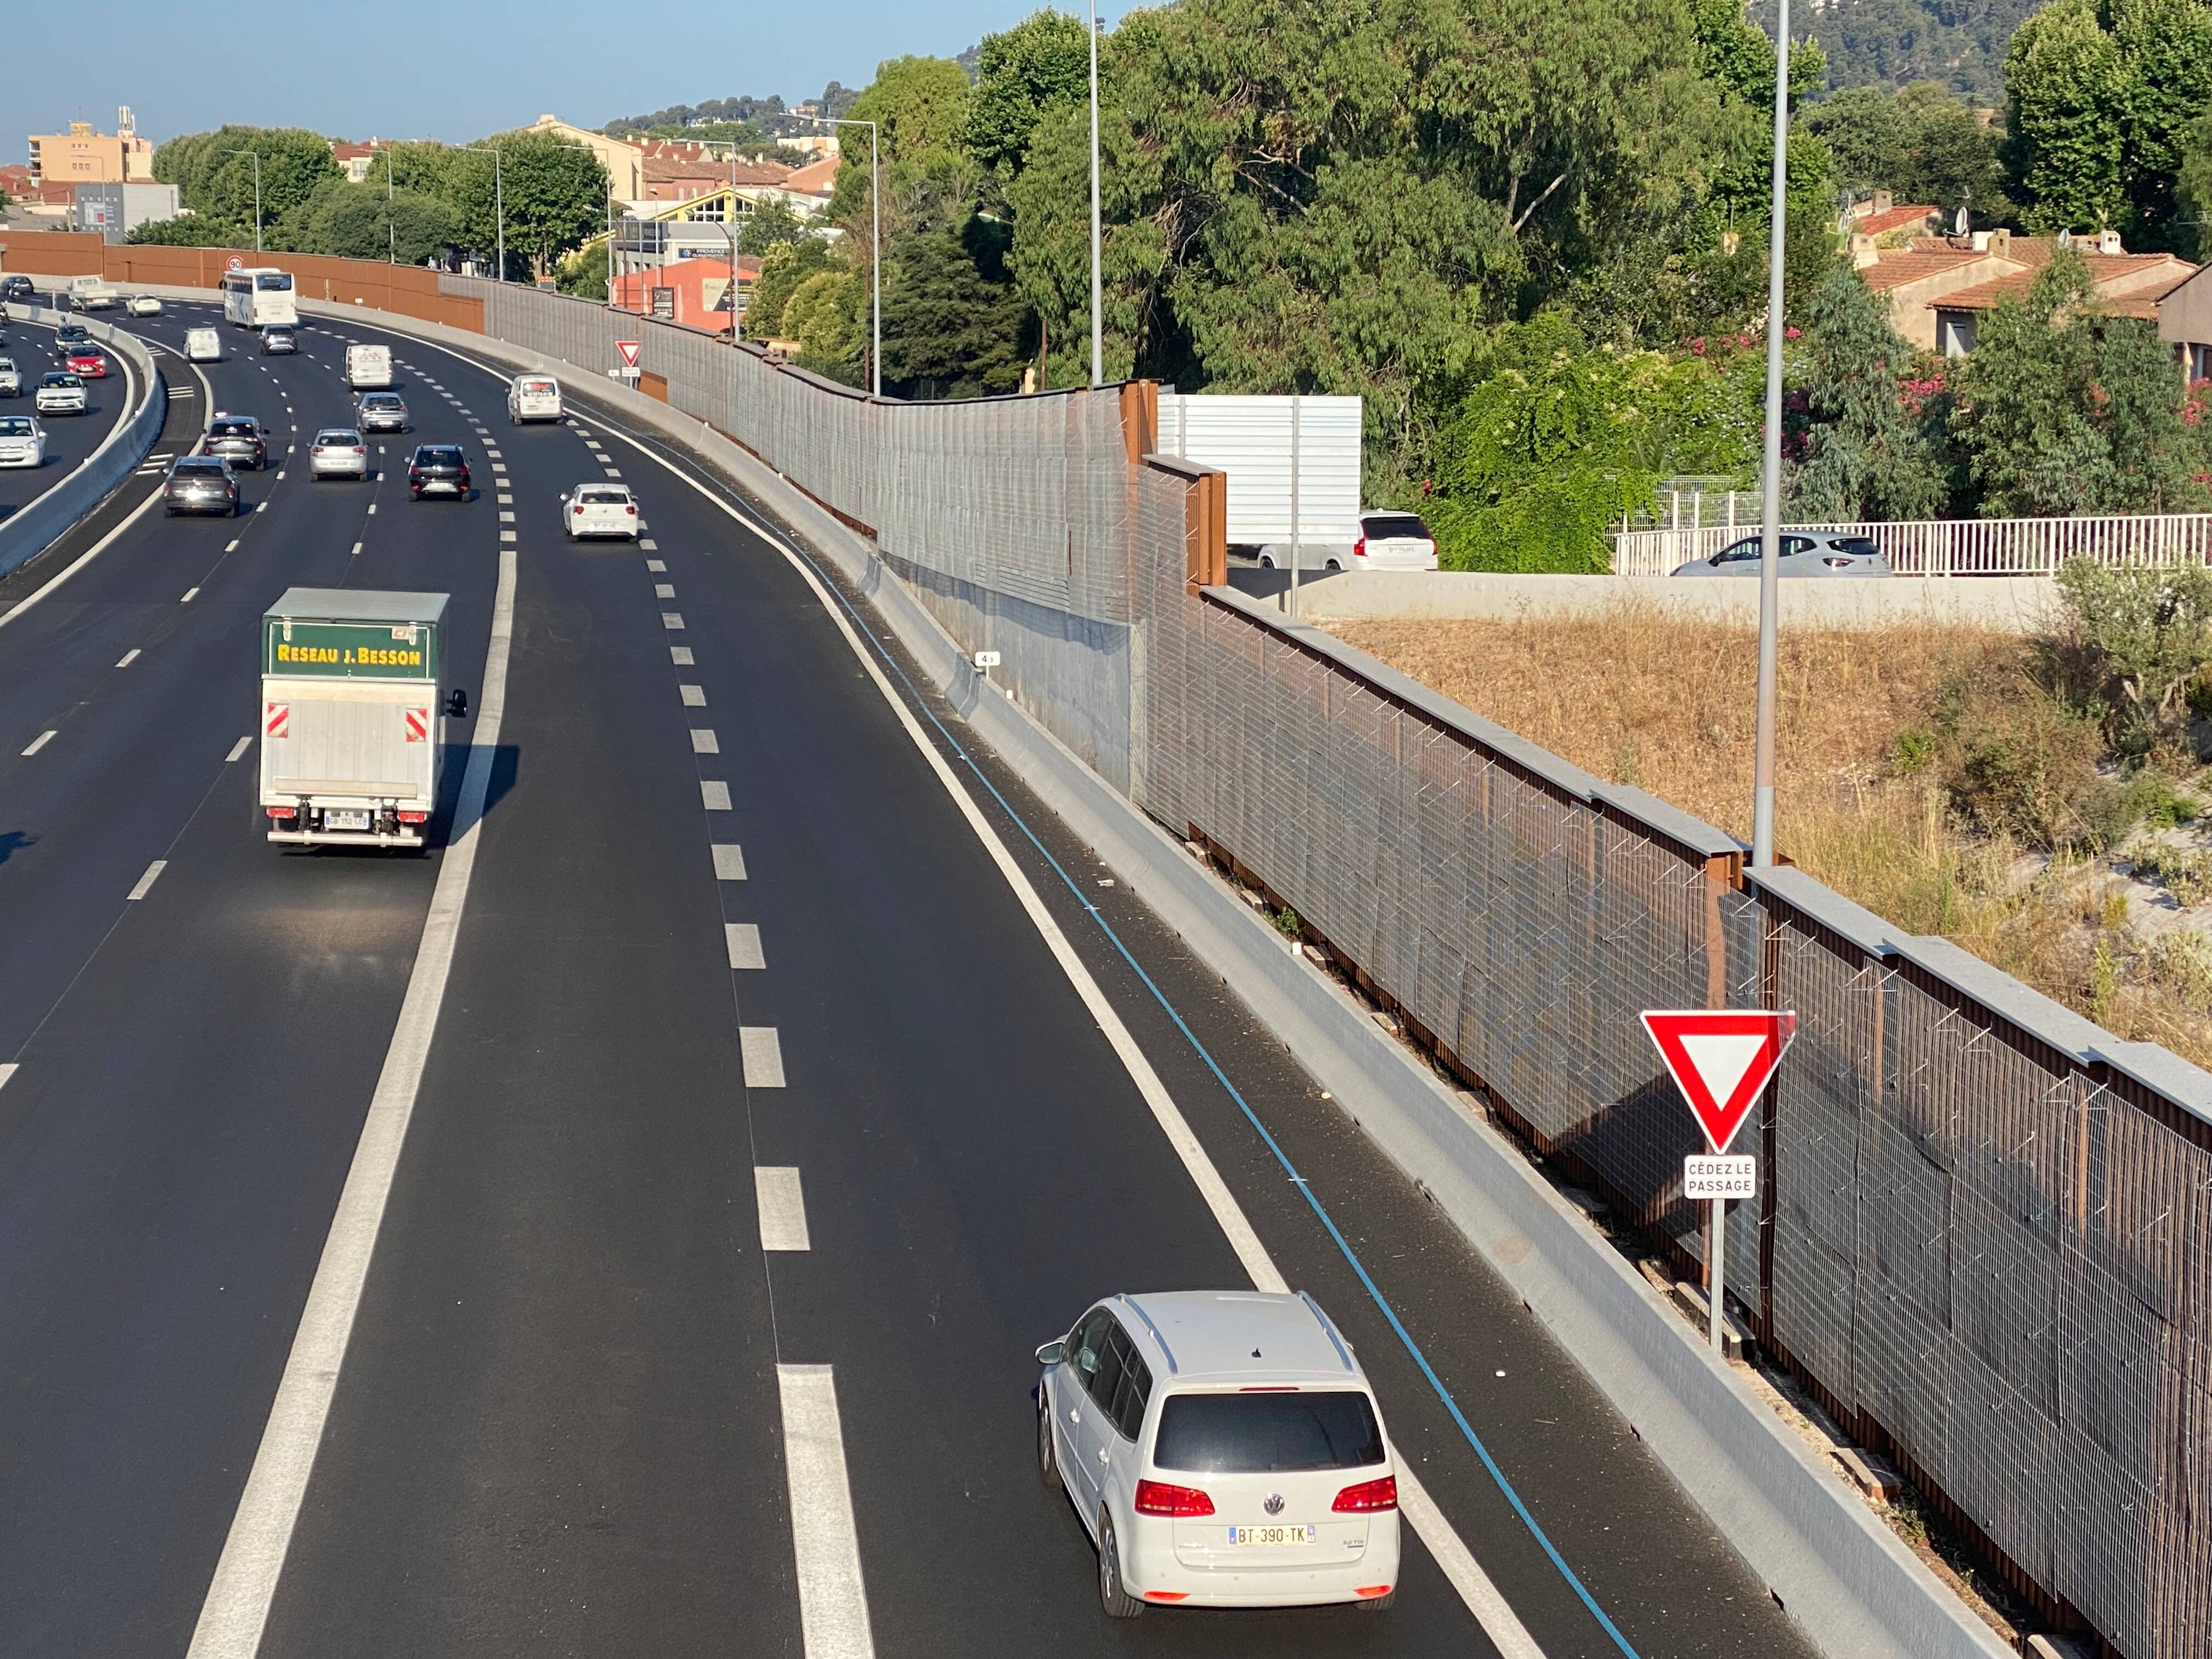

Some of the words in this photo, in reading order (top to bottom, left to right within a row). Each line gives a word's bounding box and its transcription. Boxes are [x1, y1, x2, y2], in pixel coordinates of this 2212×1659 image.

[278, 644, 338, 663] RESEAU
[343, 650, 356, 664] J.
[358, 647, 421, 665] BESSON
[1689, 1161, 1732, 1175] CÉDEZ
[1736, 1164, 1752, 1175] LE
[1689, 1181, 1751, 1191] PASSAGE
